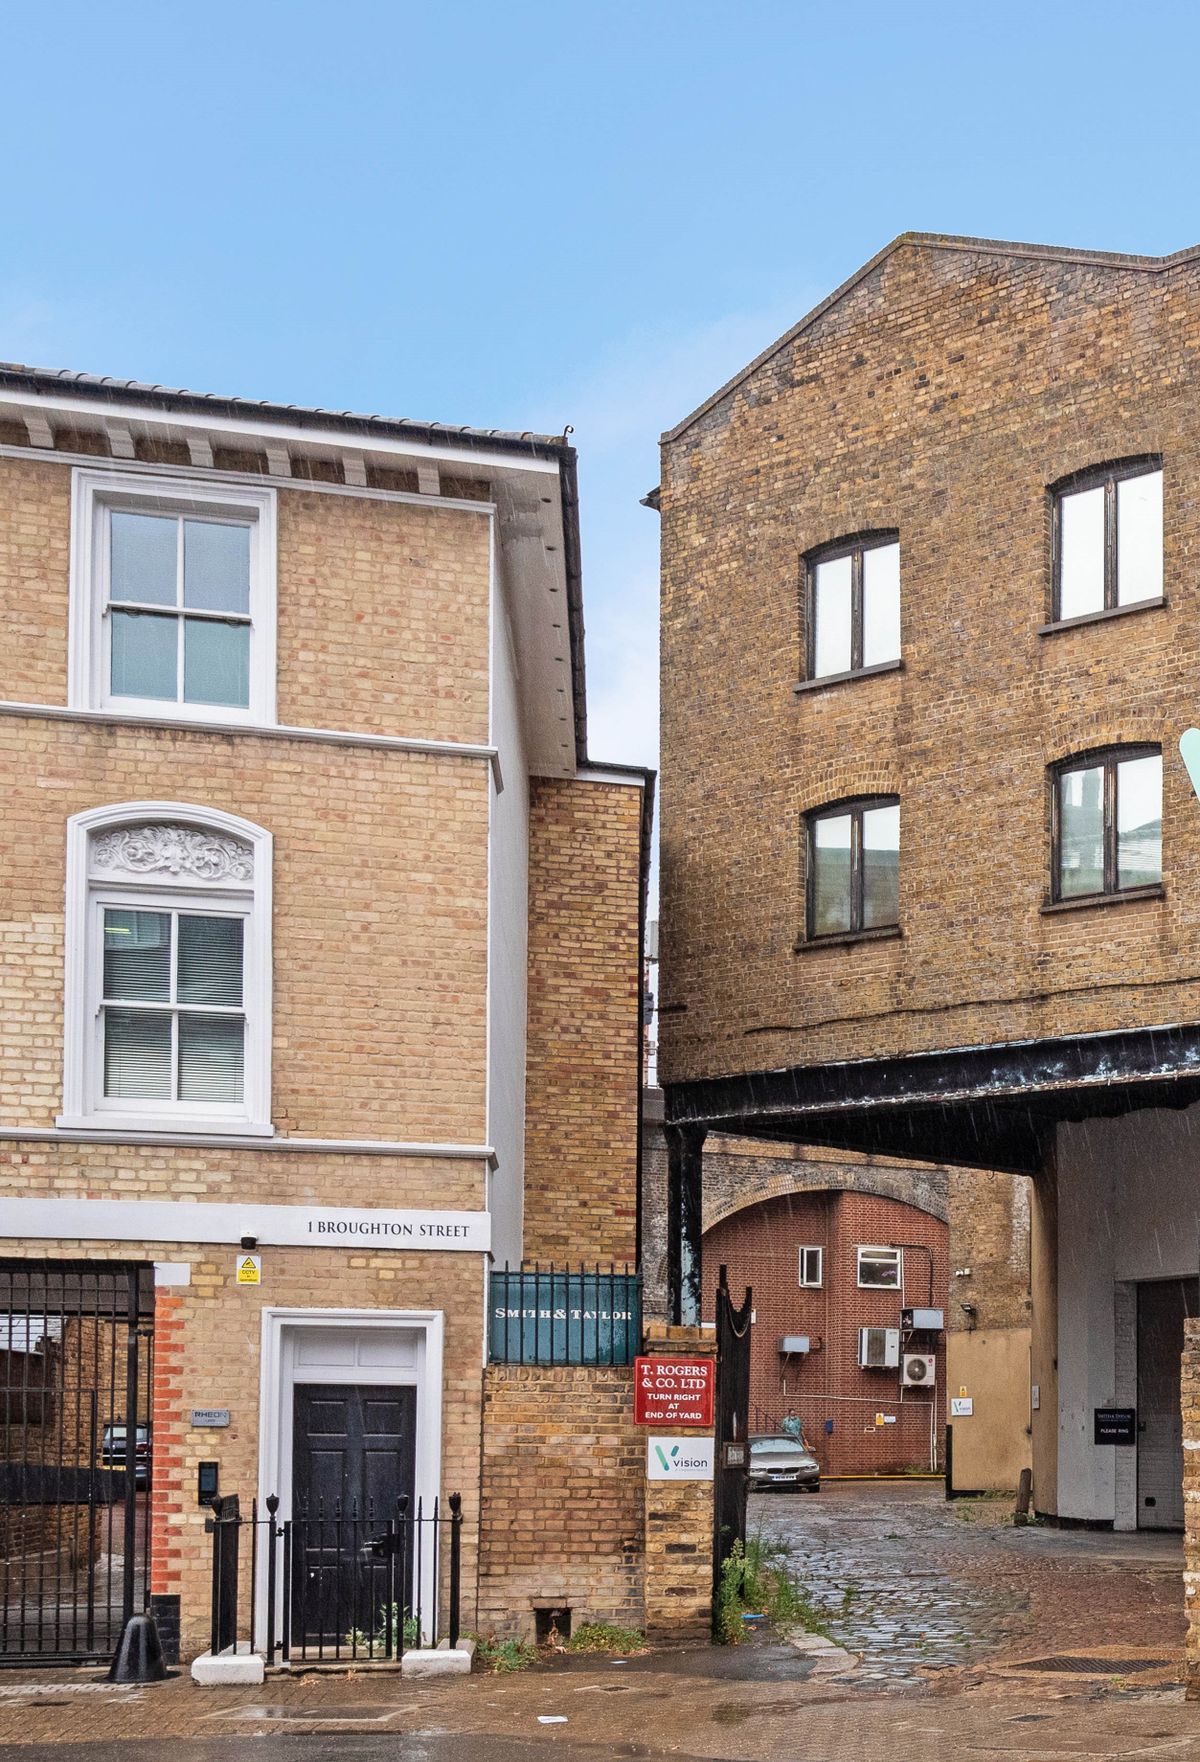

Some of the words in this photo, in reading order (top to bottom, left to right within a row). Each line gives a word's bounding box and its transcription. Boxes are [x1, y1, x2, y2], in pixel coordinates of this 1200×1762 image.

[318, 1221, 413, 1236] BROUGHTON
[419, 1224, 470, 1237] STREET
[640, 1364, 654, 1375] T.
[656, 1365, 708, 1377] ROGERS
[641, 1377, 653, 1388] &
[655, 1378, 678, 1388] CO.
[680, 1378, 706, 1389] LTD
[674, 1393, 701, 1401] RIGHT
[645, 1411, 664, 1419] END
[679, 1412, 702, 1420] YARD
[673, 1457, 708, 1467] vision
